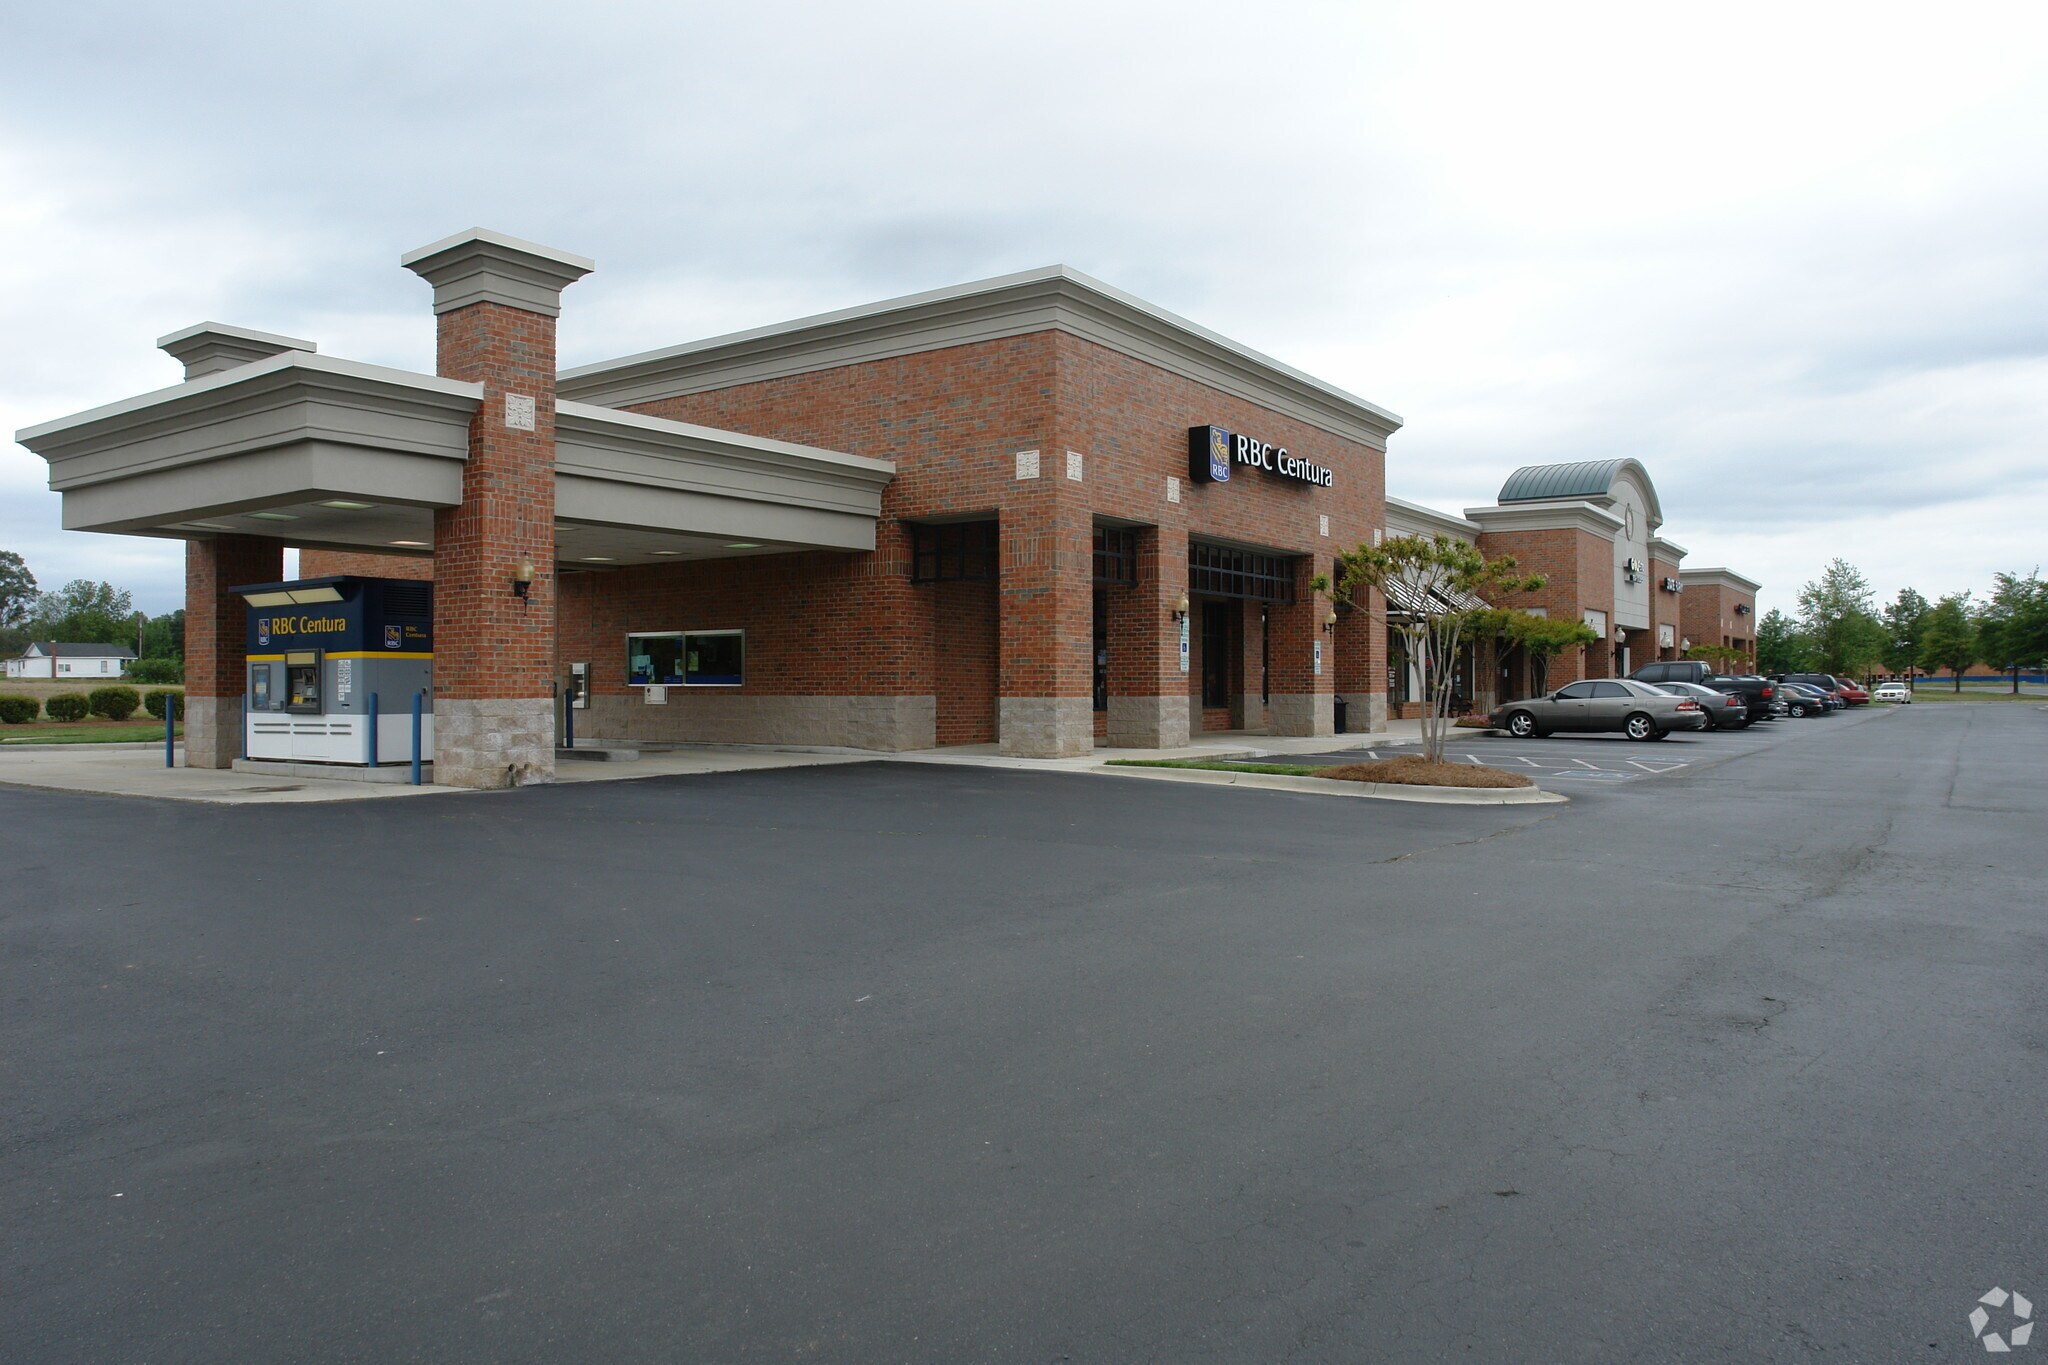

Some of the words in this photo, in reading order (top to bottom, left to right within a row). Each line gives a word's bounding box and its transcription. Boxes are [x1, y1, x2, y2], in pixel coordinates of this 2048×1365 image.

[1237, 434, 1273, 471] RBC
[1277, 447, 1333, 487] Centura
[1212, 463, 1228, 478] RBC
[272, 616, 297, 635] RBC
[300, 616, 346, 634] Centura
